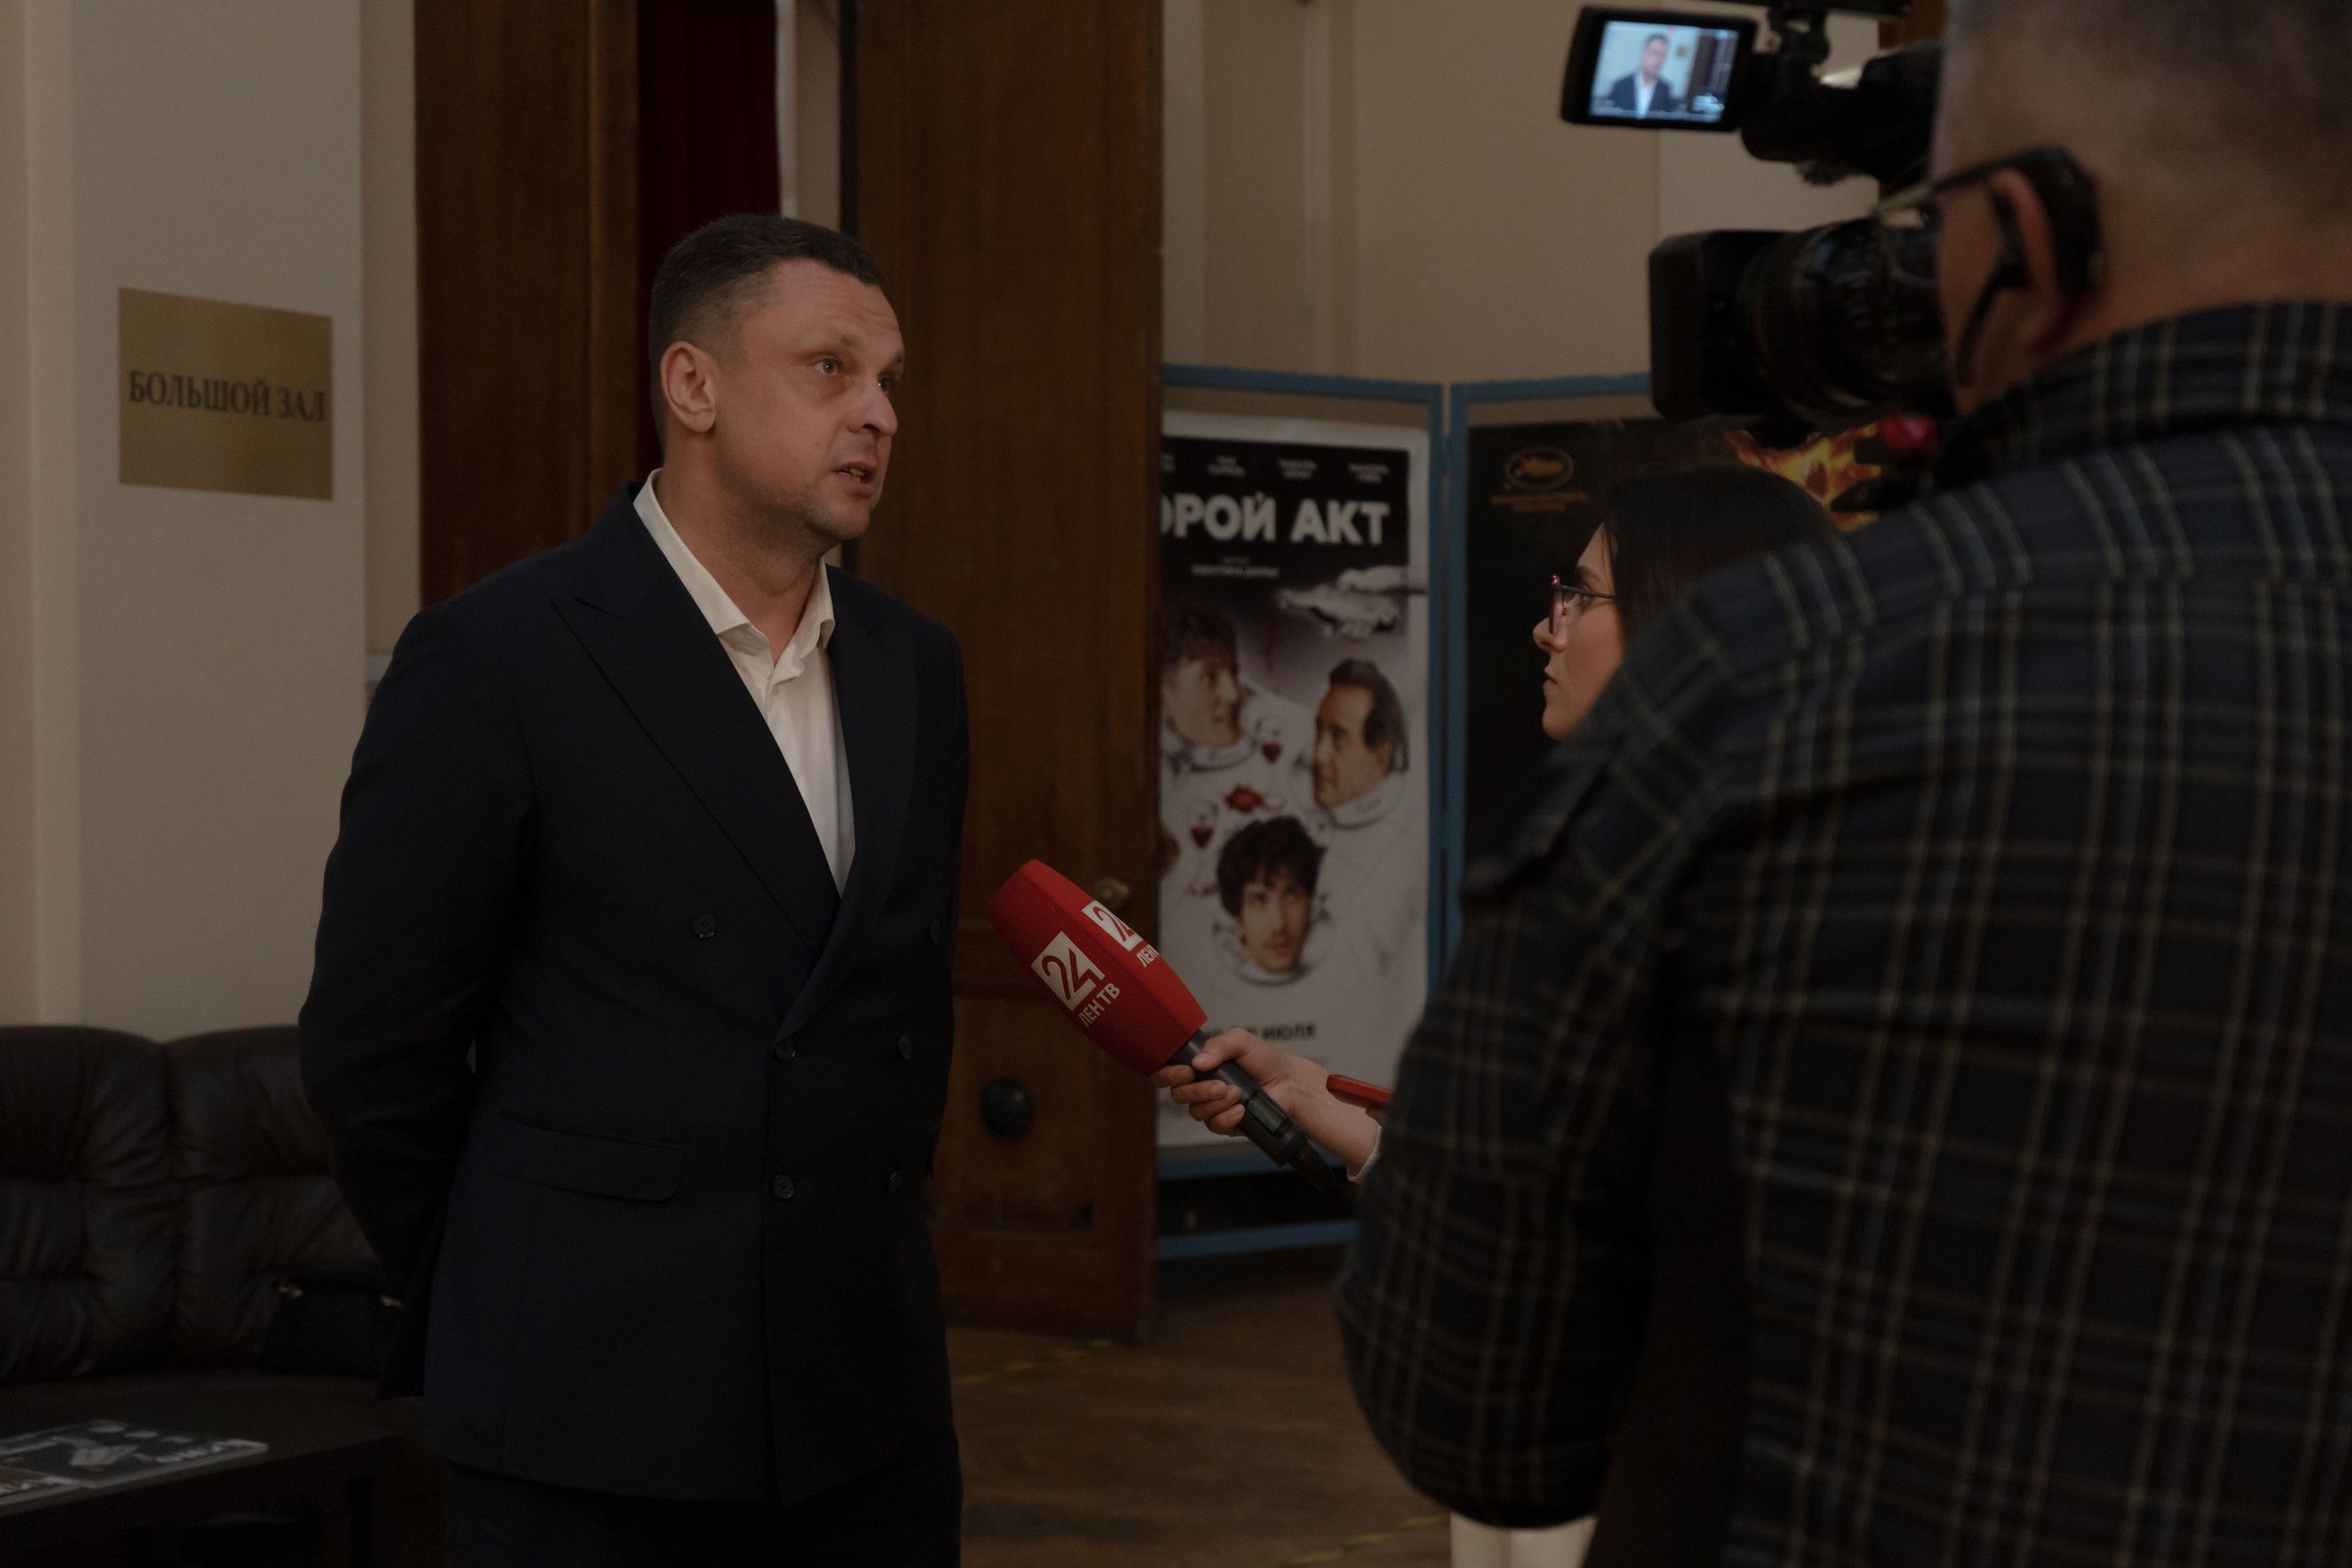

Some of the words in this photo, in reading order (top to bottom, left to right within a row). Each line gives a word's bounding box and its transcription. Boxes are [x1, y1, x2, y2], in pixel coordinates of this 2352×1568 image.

[129, 369, 270, 415] БОЛЬШОЙ
[277, 387, 326, 422] ЗАЛ
[1288, 498, 1391, 547] АКТ
[1040, 946, 1103, 1002] 24
[1078, 998, 1105, 1028] ЛЕН
[1095, 982, 1121, 1005] ТВ
